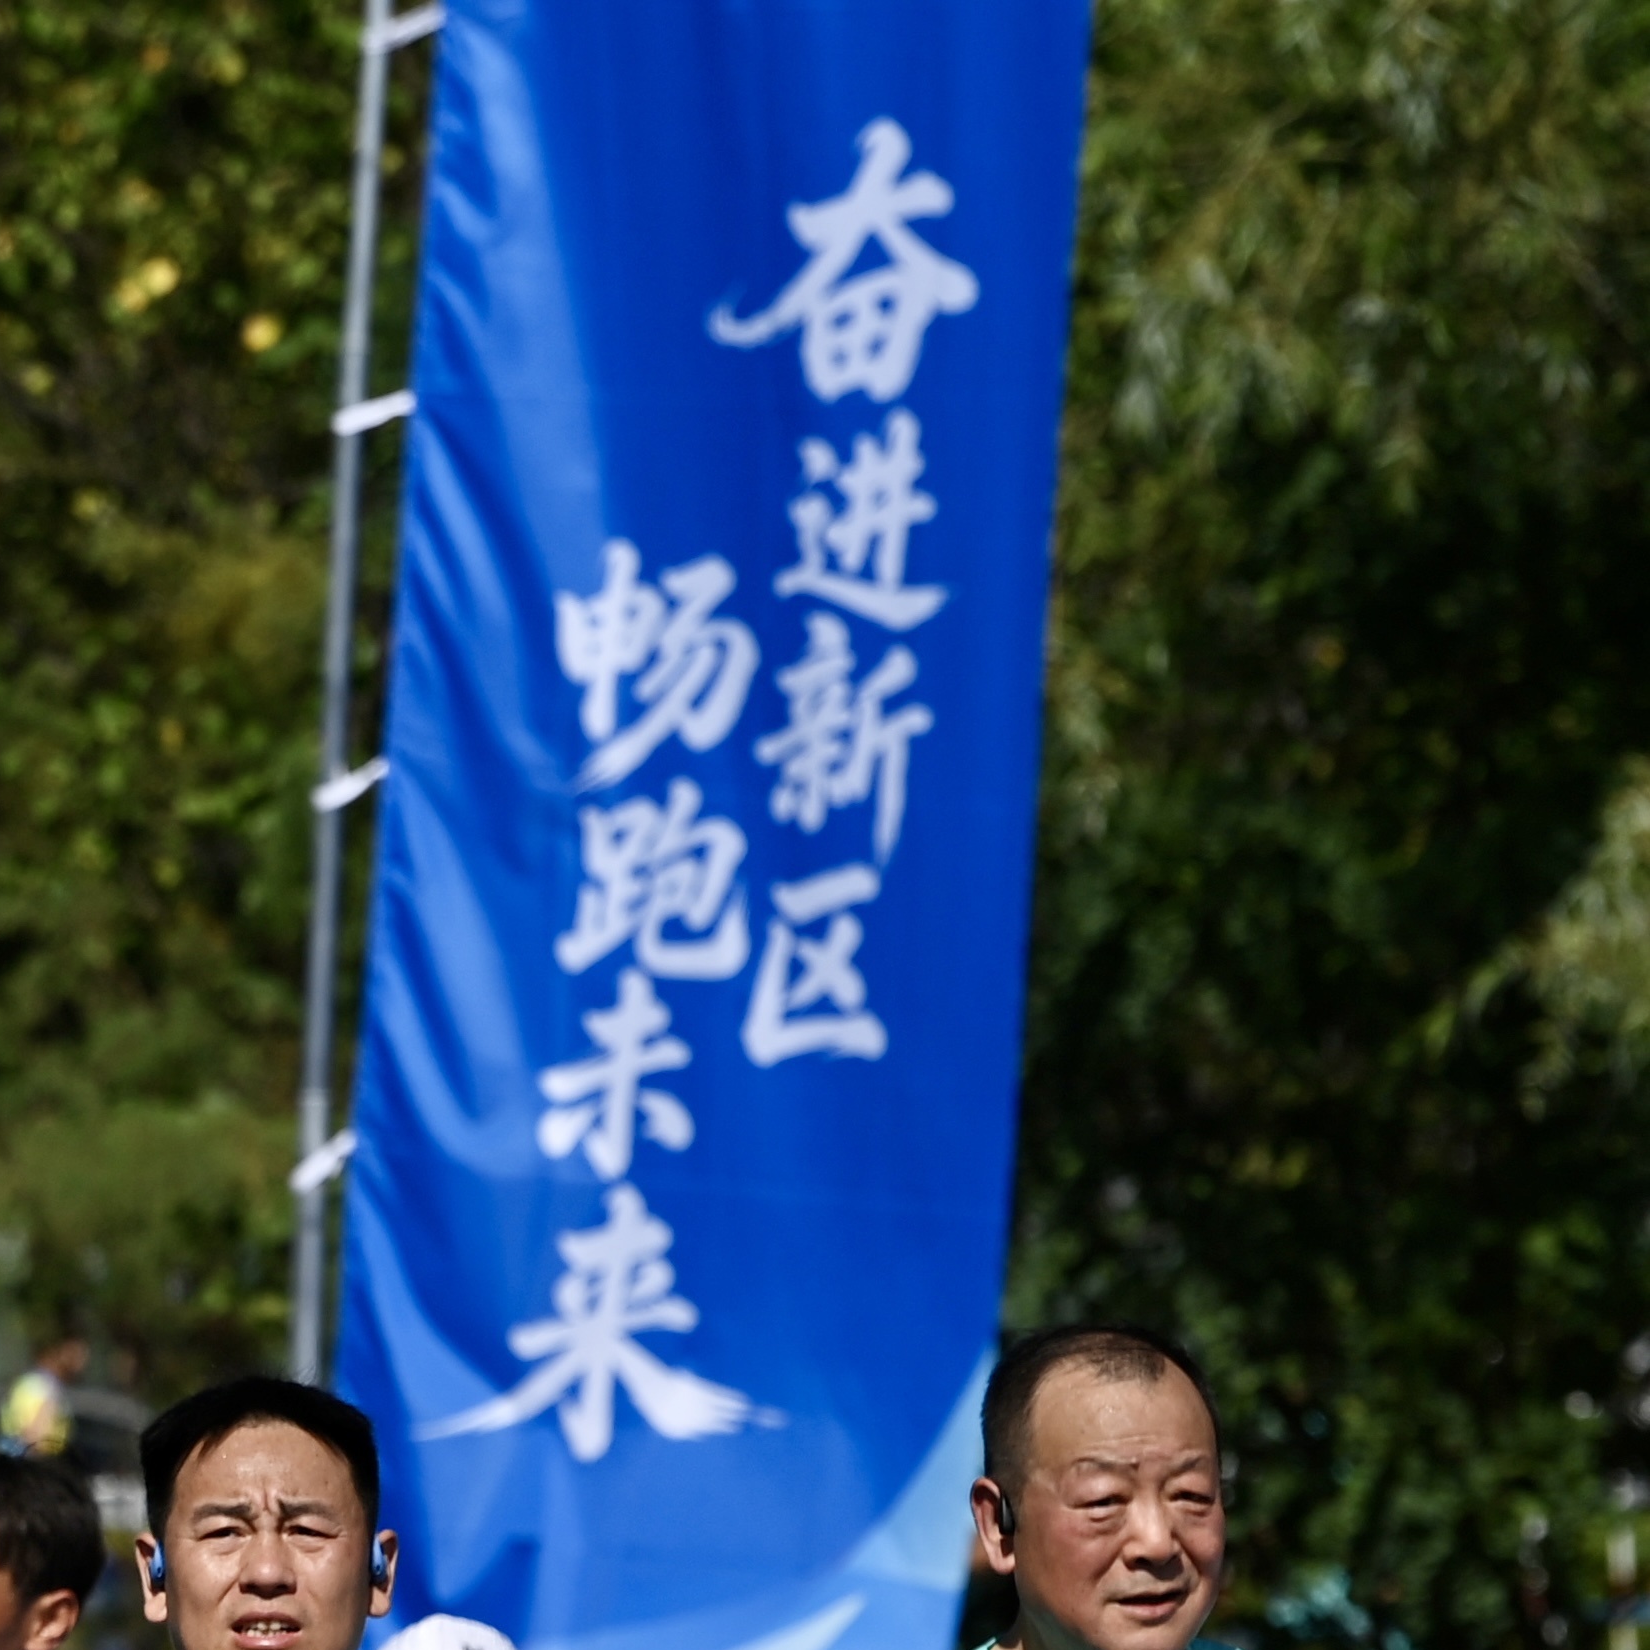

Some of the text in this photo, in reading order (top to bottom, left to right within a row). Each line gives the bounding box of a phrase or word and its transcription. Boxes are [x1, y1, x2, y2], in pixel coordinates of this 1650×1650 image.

[407, 536, 789, 1464] 畅跑未来
[707, 117, 980, 1068] 奋进新区
